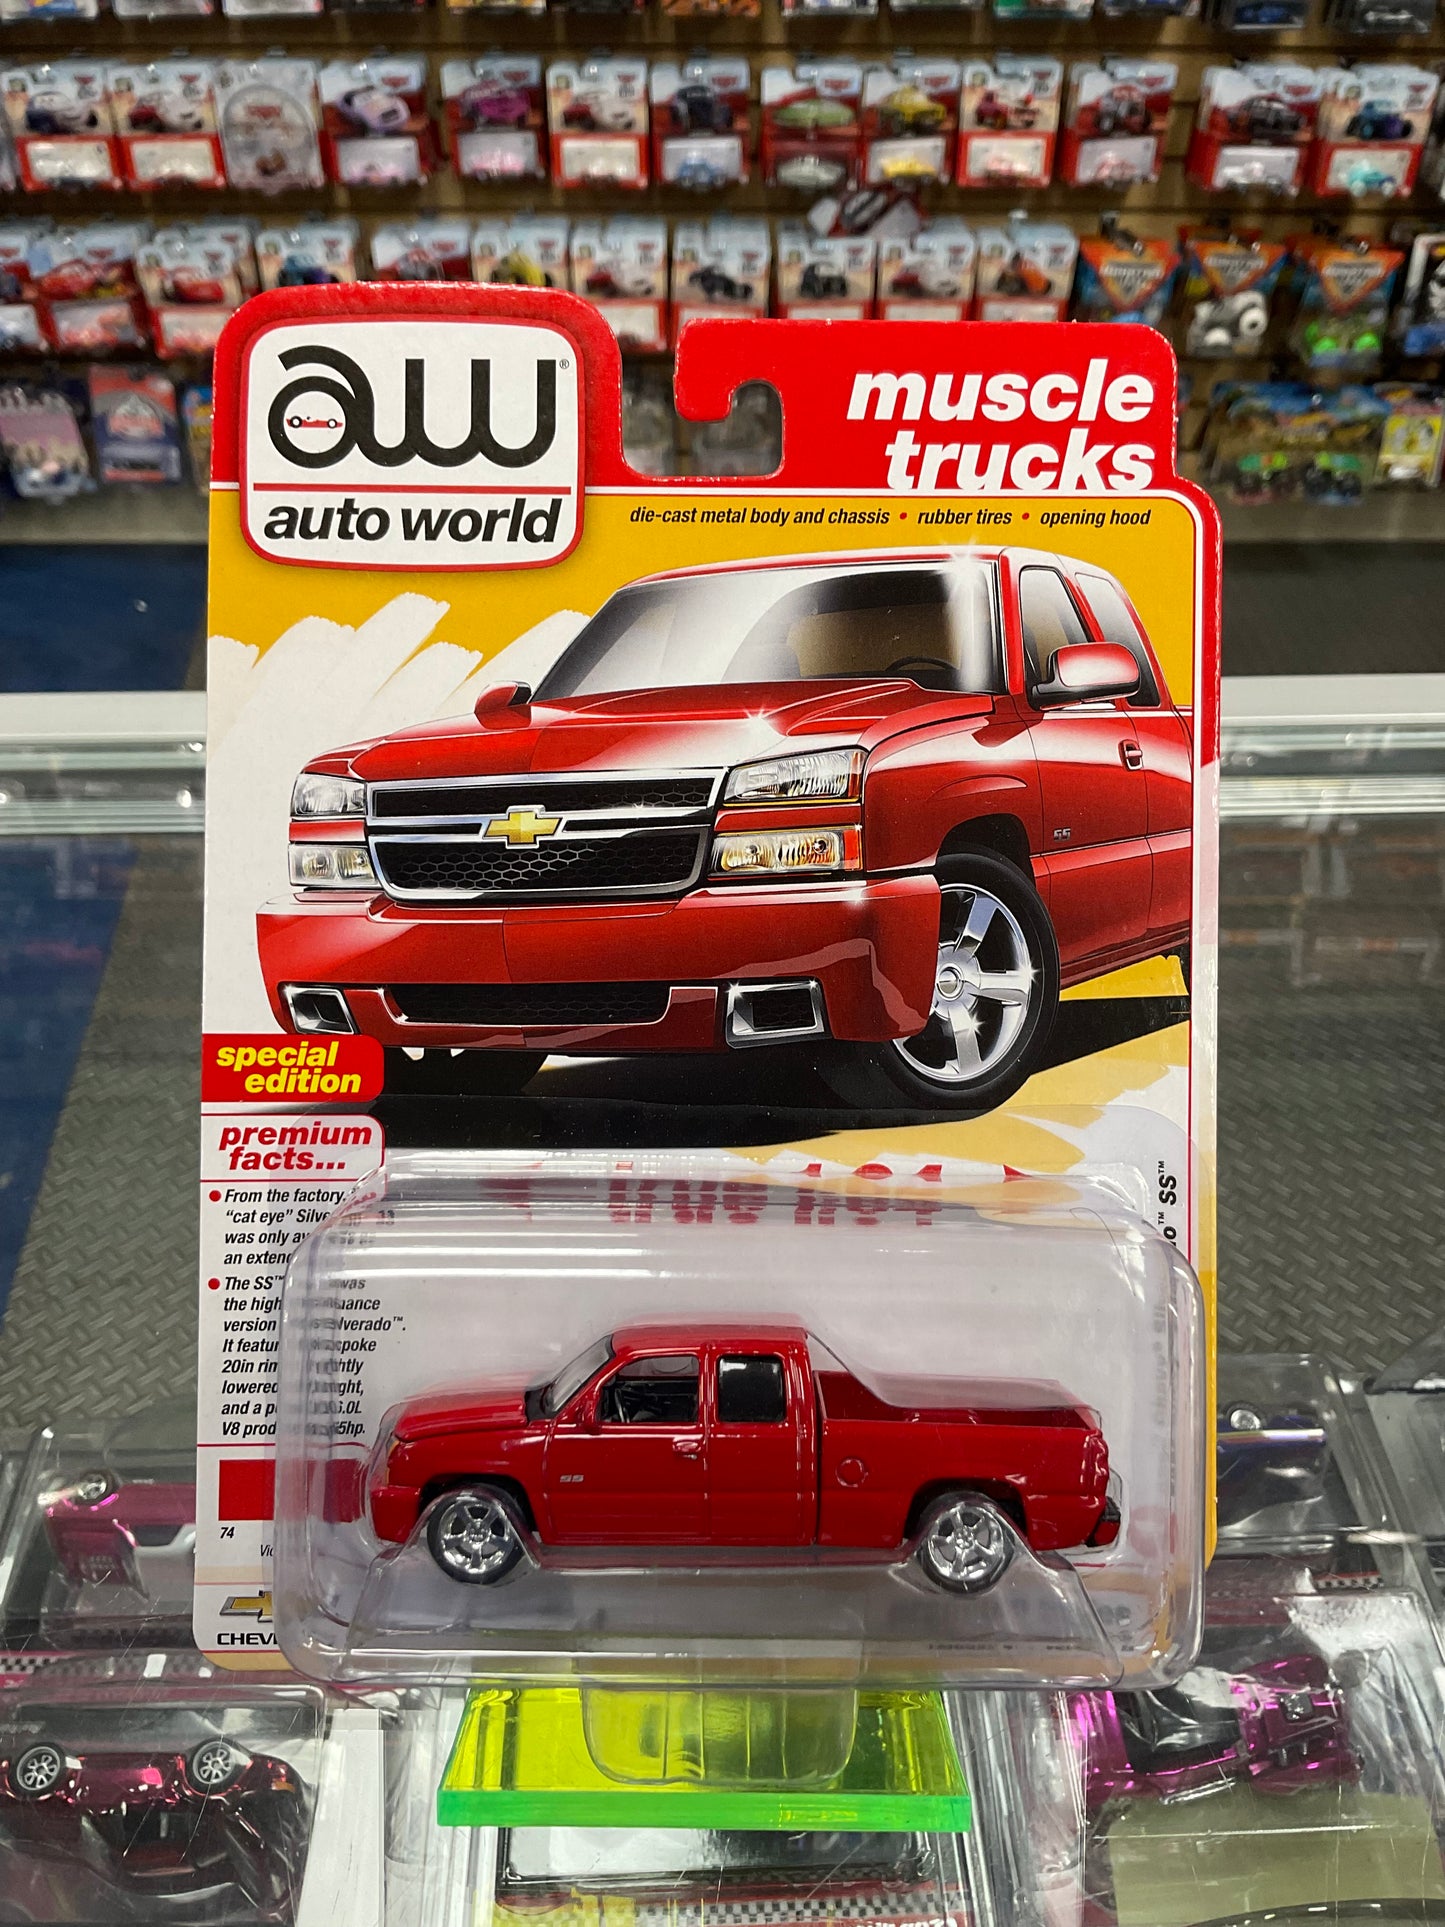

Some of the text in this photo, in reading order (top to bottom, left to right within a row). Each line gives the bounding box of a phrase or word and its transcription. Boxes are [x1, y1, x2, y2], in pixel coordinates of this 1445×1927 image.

[846, 358, 1154, 422] muscle
[885, 428, 1155, 490] trucks
[264, 498, 562, 543] auto world
[630, 507, 890, 526] die-cast metal body and chassis
[917, 509, 1013, 525] rubber tires
[1040, 509, 1151, 528] opening hood
[216, 1041, 339, 1071] special
[245, 1068, 361, 1093] edition
[219, 1121, 372, 1150] premium
[229, 1147, 346, 1170] facts...
[225, 1189, 262, 1203] From
[266, 1189, 290, 1203] the
[225, 1233, 254, 1244] was
[258, 1231, 290, 1246] only
[224, 1254, 242, 1265] an
[225, 1276, 250, 1290] The
[224, 1297, 247, 1311] the
[224, 1317, 276, 1332] version
[222, 1339, 235, 1353] It
[222, 1359, 254, 1373] 20in
[221, 1401, 249, 1415] and
[253, 1404, 262, 1415] a
[222, 1421, 240, 1436] V8
[220, 1526, 235, 1539] 74
